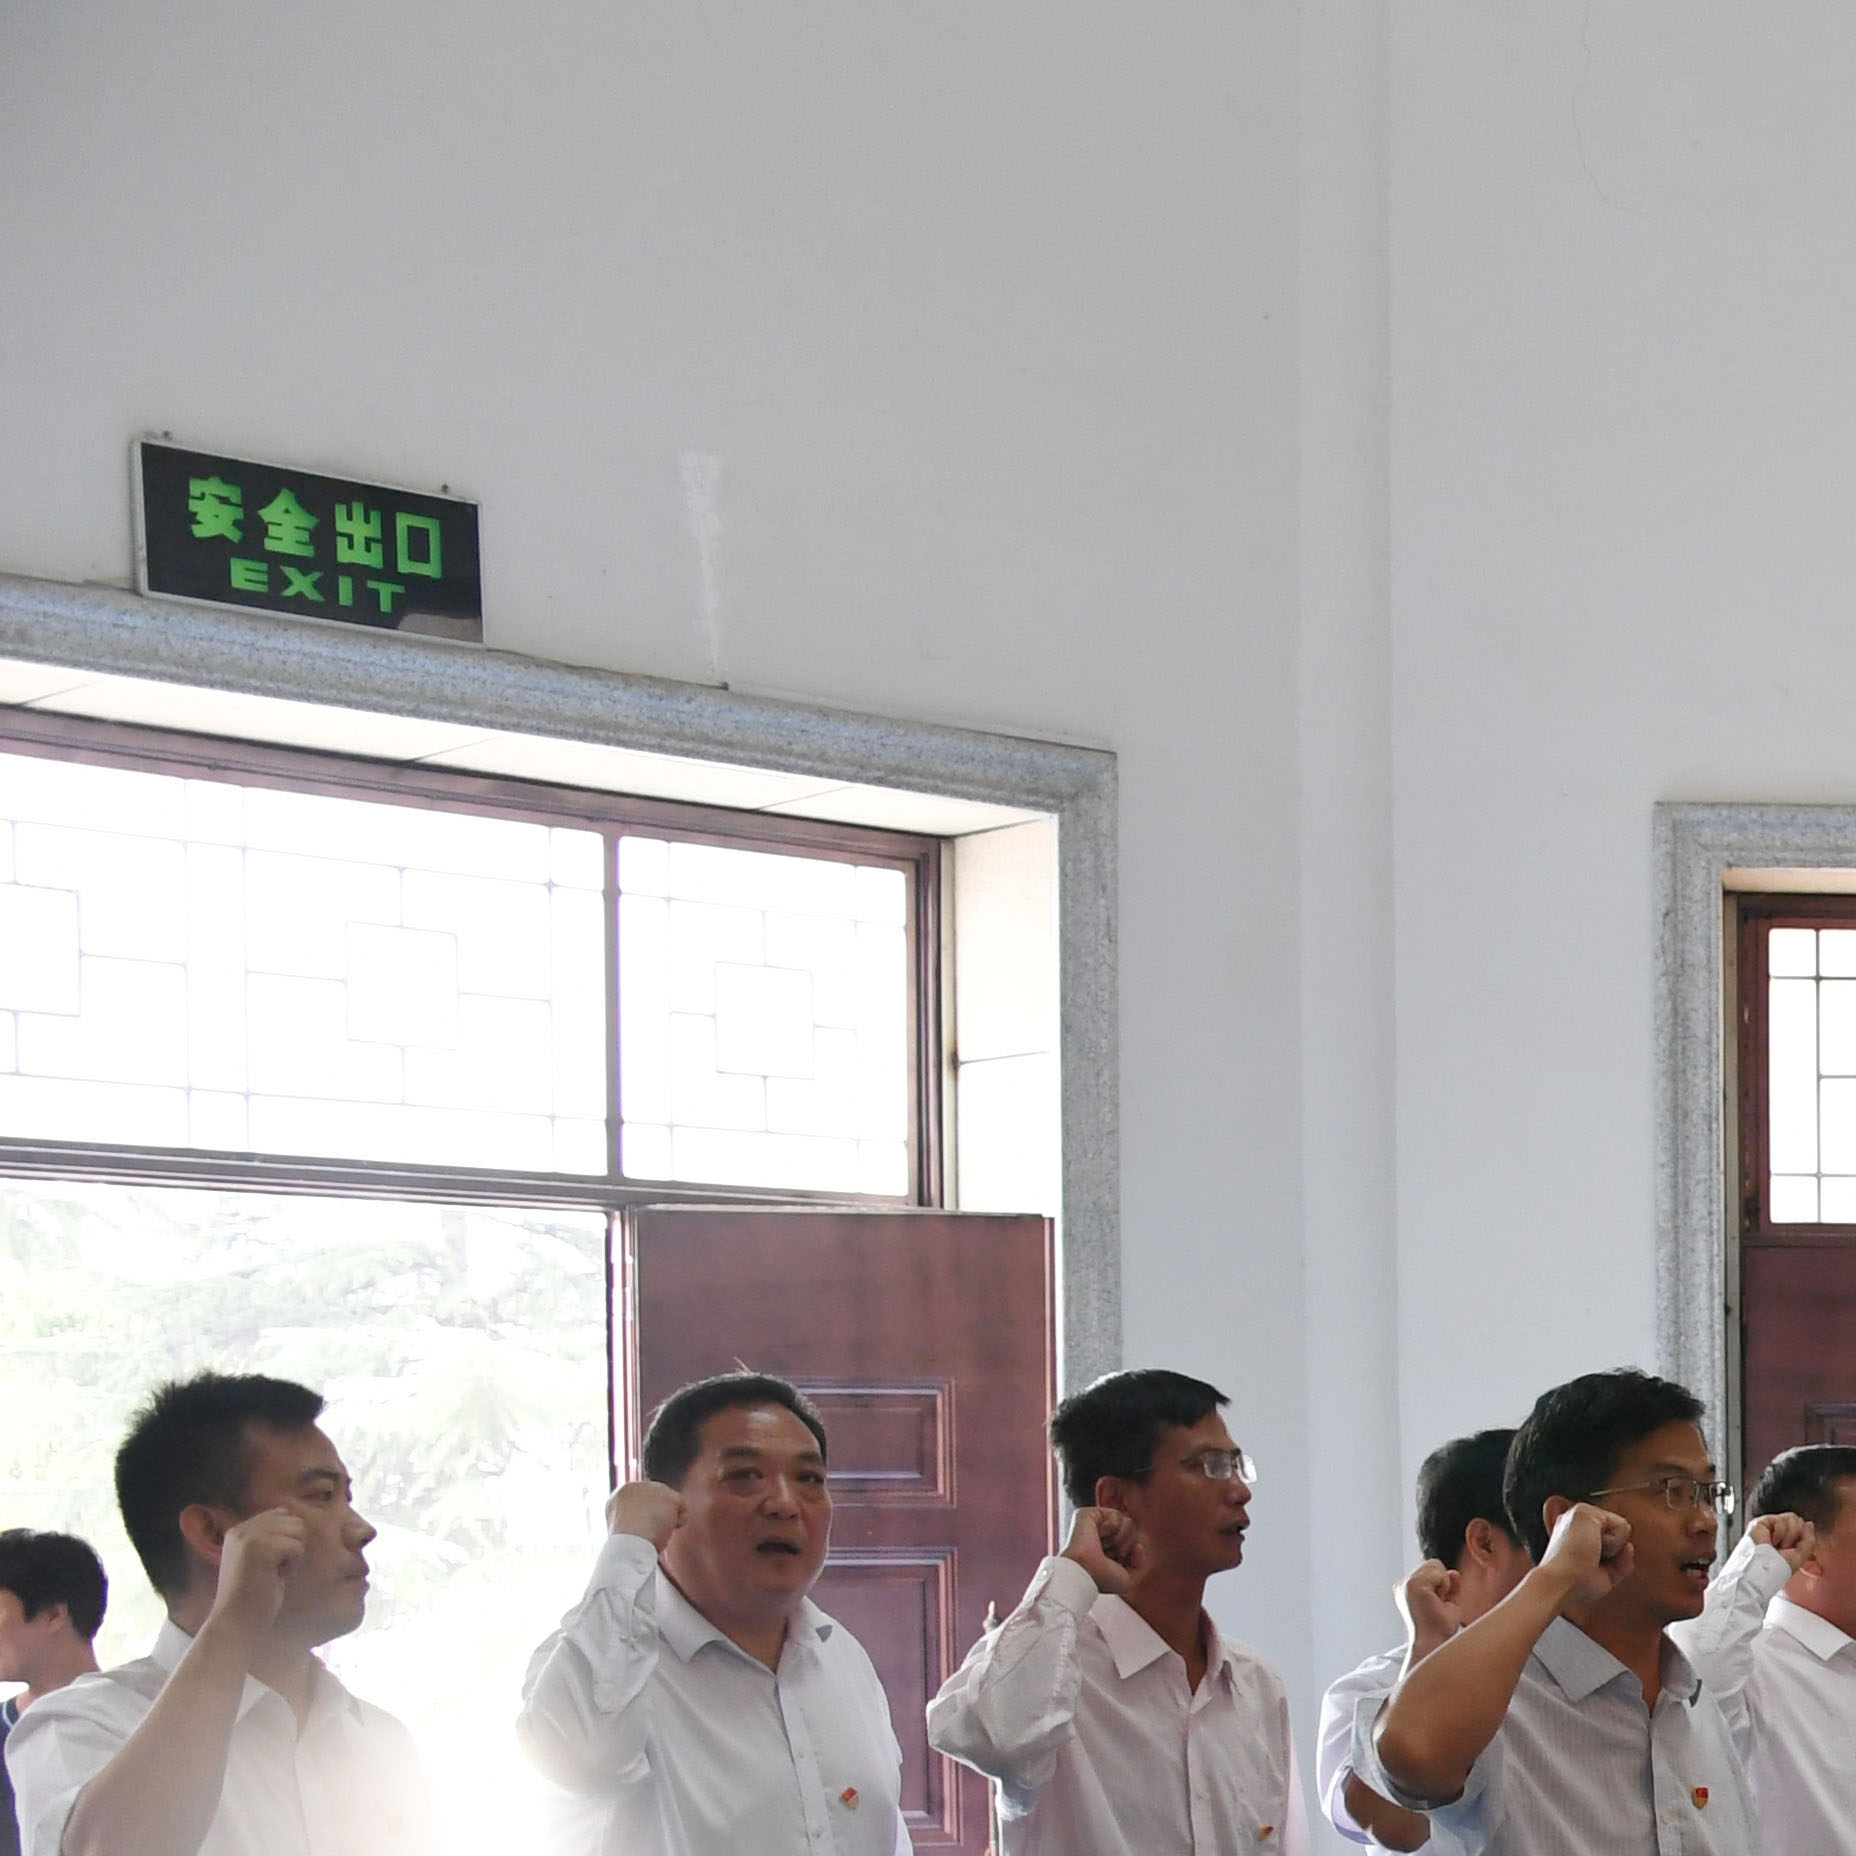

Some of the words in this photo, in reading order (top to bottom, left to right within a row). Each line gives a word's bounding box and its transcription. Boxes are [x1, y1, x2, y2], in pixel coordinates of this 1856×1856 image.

[188, 476, 443, 580] 安全出口
[229, 557, 406, 613] EXIT
